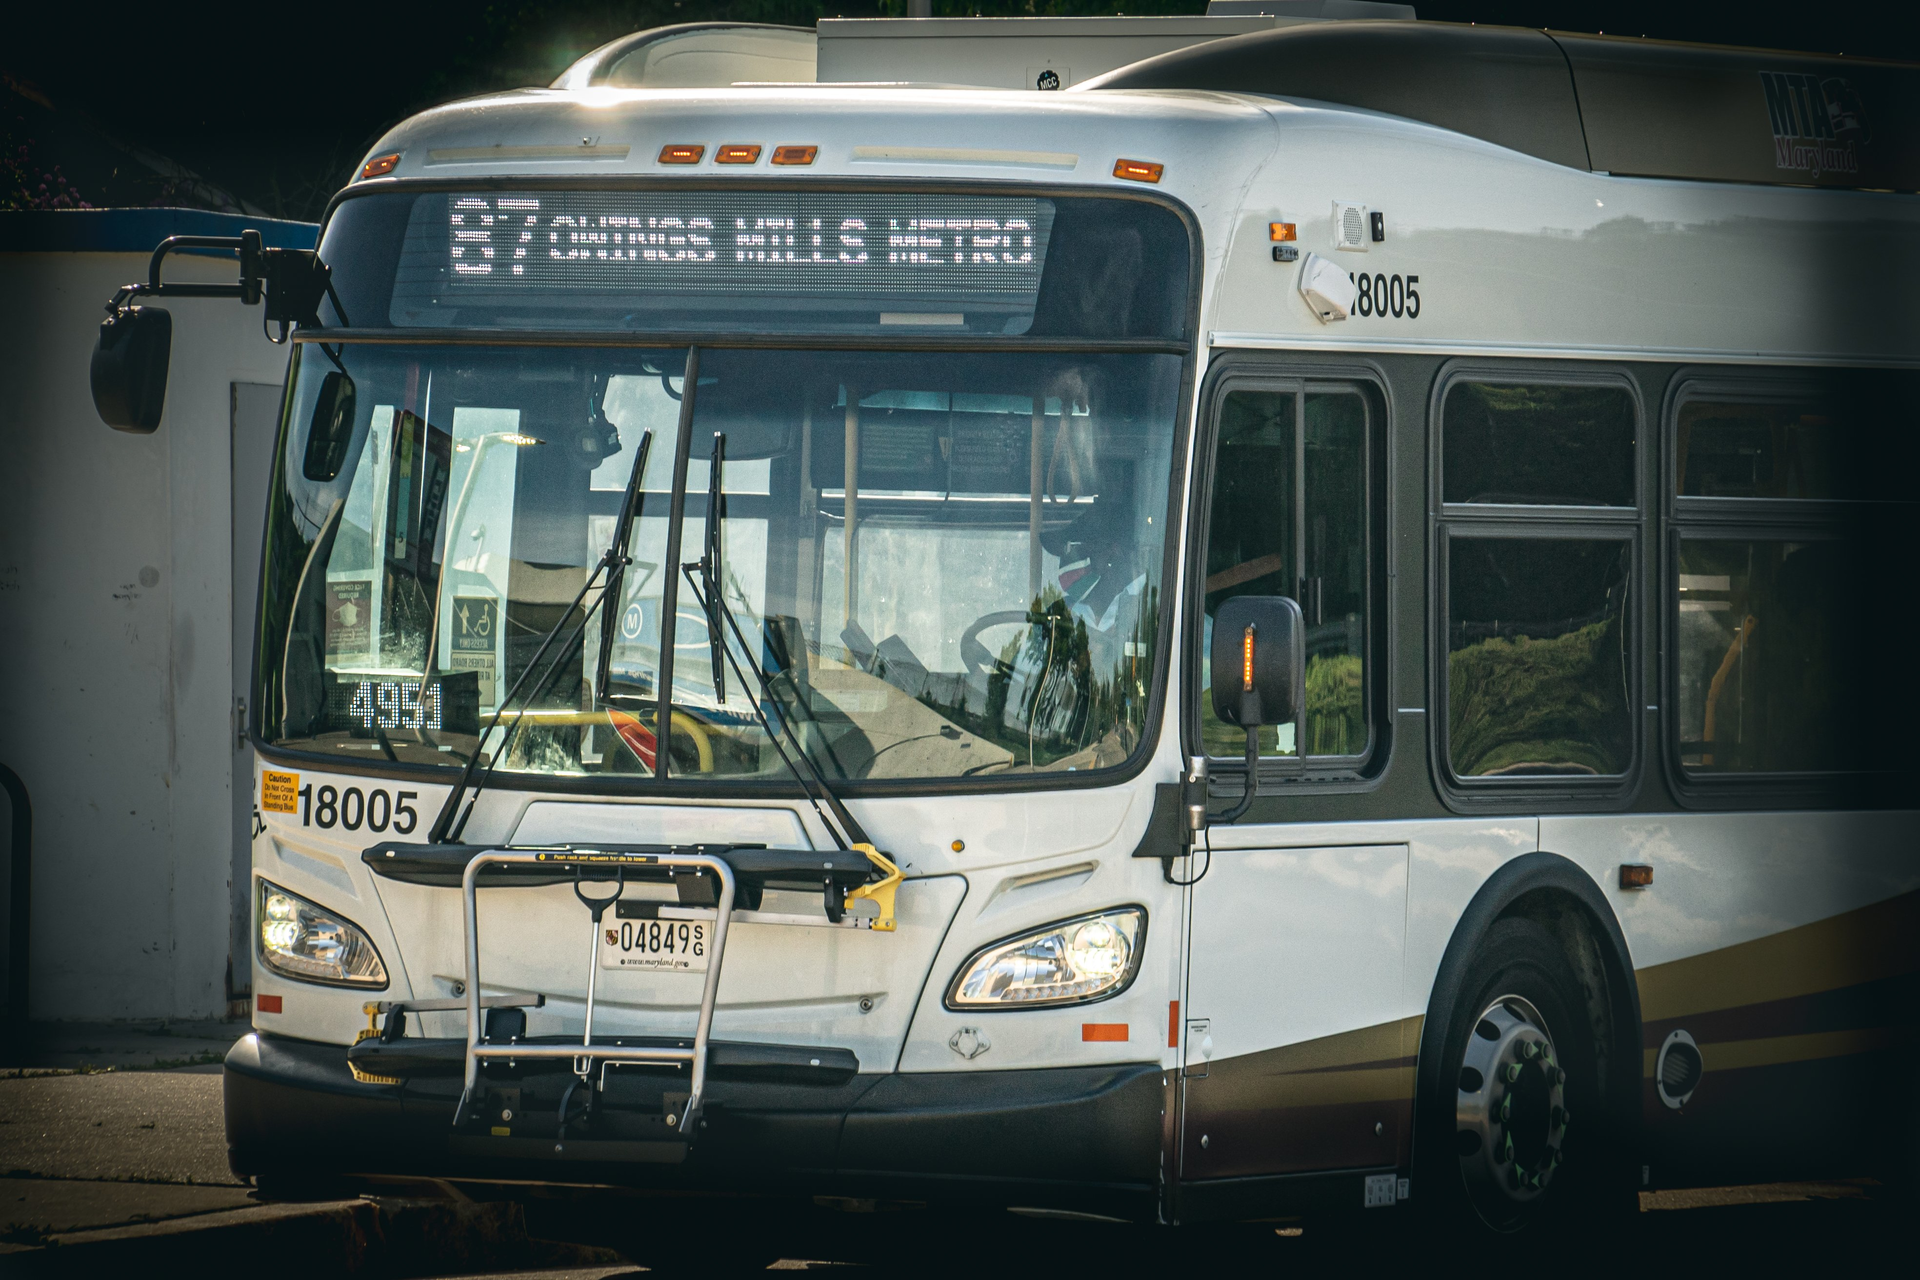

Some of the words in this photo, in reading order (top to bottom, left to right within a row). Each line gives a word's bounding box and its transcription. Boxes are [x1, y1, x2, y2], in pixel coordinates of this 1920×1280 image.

[1040, 76, 1057, 90] MCC
[1758, 71, 1836, 141] MTA
[1775, 137, 1858, 178] Maryland
[452, 198, 539, 275] 87
[550, 216, 716, 261] OWINGS
[736, 218, 869, 263] MILLS
[889, 219, 1032, 263] METRO
[349, 682, 442, 729] 4951
[264, 783, 271, 791] Do
[268, 774, 292, 784] Caution
[264, 801, 283, 811] Standing
[284, 803, 294, 811] Bus
[269, 793, 281, 801] Front
[298, 783, 418, 835] 18005
[621, 921, 690, 954] 04849
